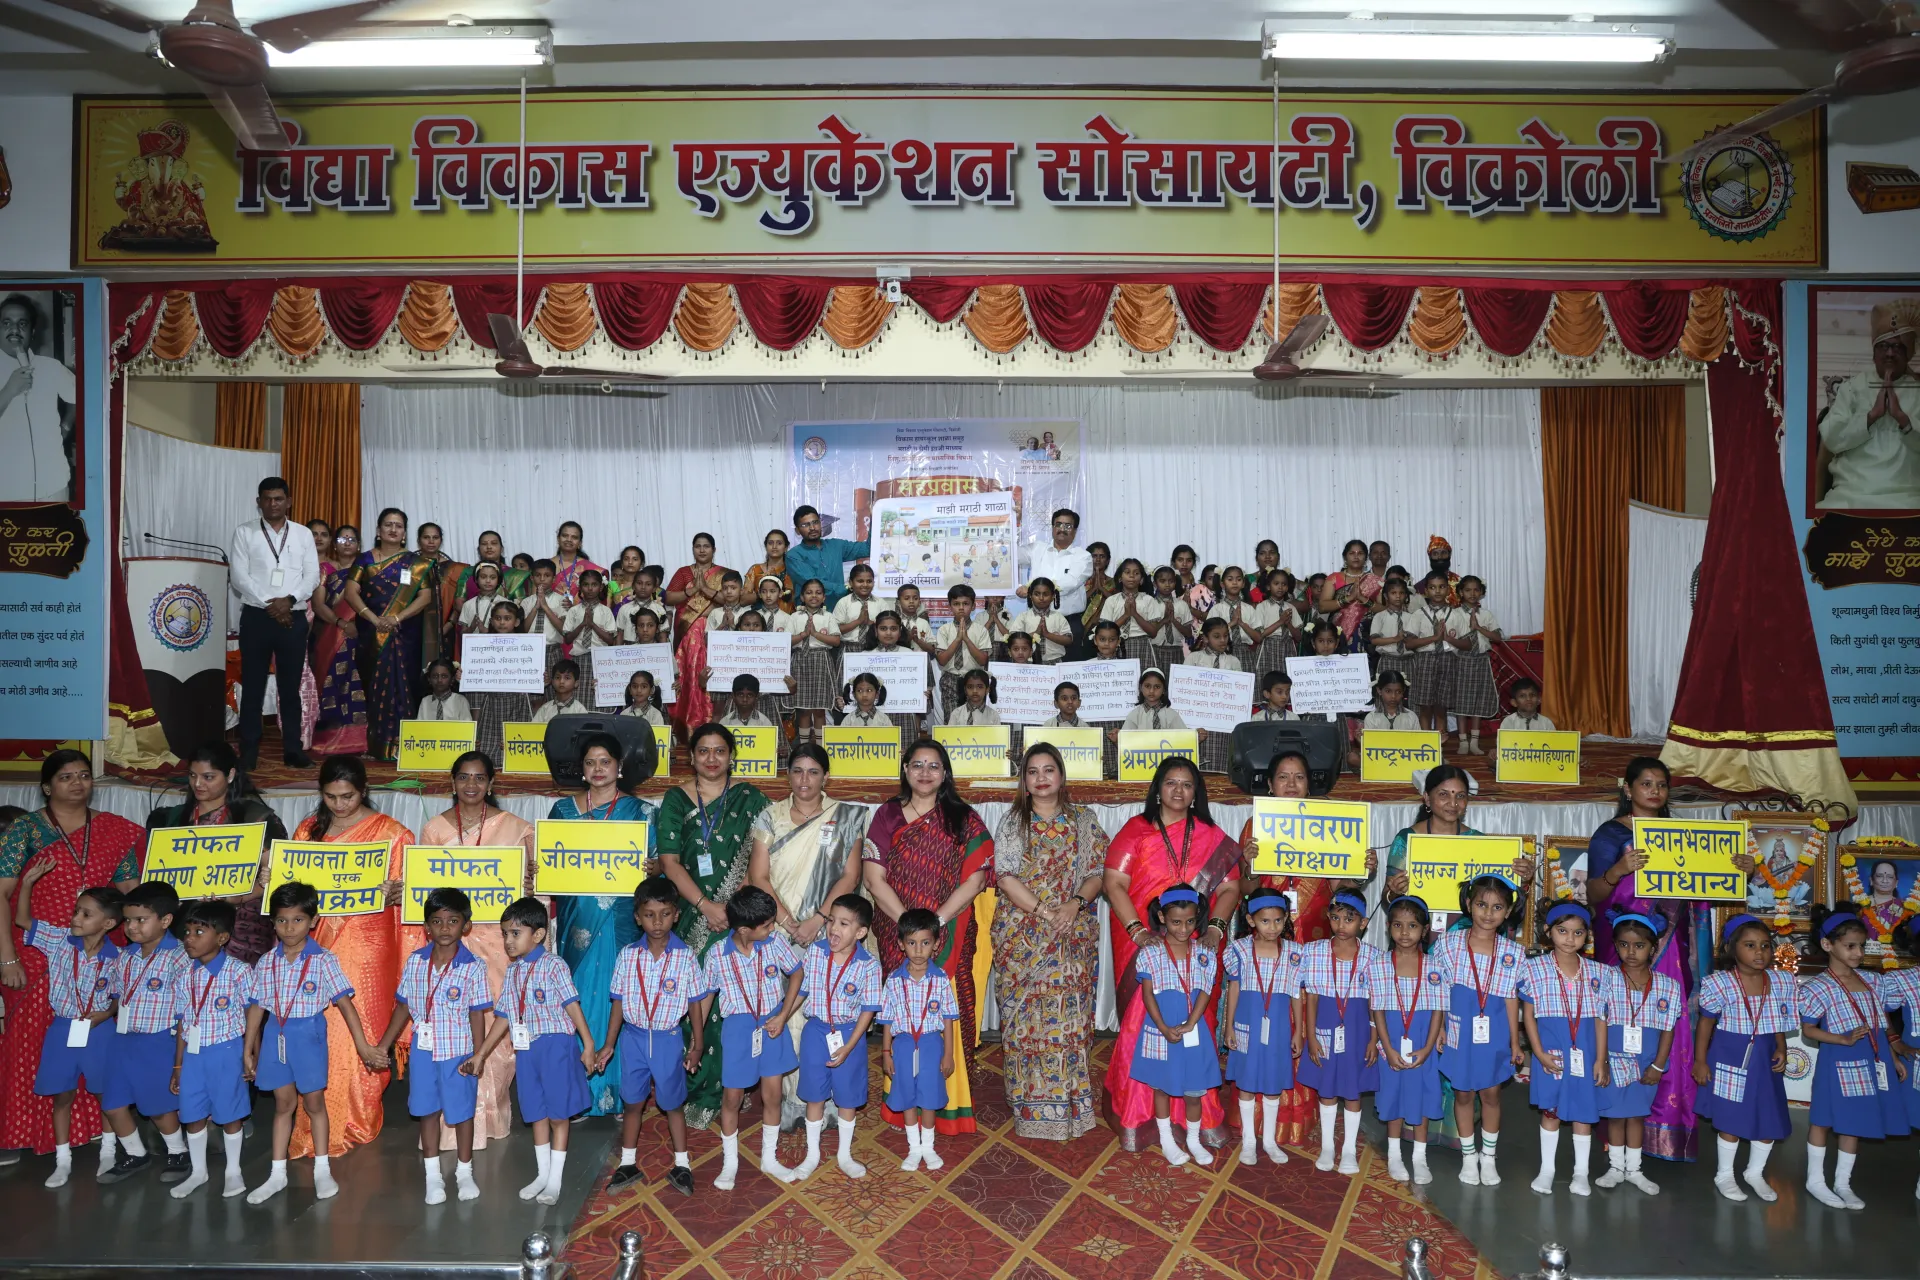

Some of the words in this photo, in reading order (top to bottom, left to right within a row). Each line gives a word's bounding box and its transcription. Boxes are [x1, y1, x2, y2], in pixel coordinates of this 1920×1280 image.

[410, 115, 652, 209] विकास
[673, 113, 1018, 235] एज्युकेशन
[1392, 113, 1663, 217] विक्रोळी
[936, 503, 956, 514] माझी
[960, 502, 981, 513] मराठी
[985, 503, 1007, 512] शाळा
[26, 527, 58, 538] कर
[8, 531, 75, 567] जुळती
[1824, 540, 1876, 569] माझे
[884, 574, 904, 585] माझी
[908, 573, 940, 585] अस्मिता
[30, 601, 43, 613] सर्व
[45, 602, 65, 614] काही
[67, 602, 82, 614] होतं
[1832, 605, 1878, 619] शून्यामधुनी
[1881, 605, 1900, 616] विश्व
[21, 632, 35, 640] एक
[37, 630, 54, 643] सुंदर
[56, 629, 68, 640] पर्व
[70, 630, 85, 642] होतं
[1830, 634, 1851, 646] किती
[1854, 634, 1879, 648] सुगंधी
[1881, 637, 1895, 648] वृक्ष
[34, 658, 59, 668] जाणीव
[62, 658, 78, 670] आहे
[713, 654, 733, 663] मराठी
[868, 656, 899, 665] अभिमान
[1063, 672, 1081, 680] मराठी
[1856, 666, 1877, 675] माया
[8, 685, 27, 696] मोठी
[29, 685, 49, 696] उणीव
[1832, 696, 1850, 705] सत्य
[1881, 692, 1900, 705] मार्ग
[1854, 725, 1876, 734] झाला
[1878, 723, 1898, 737] तुम्ही
[439, 740, 472, 752] समानता
[826, 736, 898, 760] वक्तशीरपणा
[1365, 743, 1438, 767] राष्ट्रभक्ती
[1501, 742, 1576, 771] सर्वधर्मसहिष्णुता
[1258, 802, 1364, 844] पर्यावरण
[171, 829, 245, 855] मोफत
[1642, 827, 1741, 868] स्वानुभवाला
[282, 849, 348, 880] गुणवत्ता
[428, 850, 502, 878] मोफत
[540, 841, 643, 881] जीवनमूल्ये
[1274, 842, 1351, 871] शिक्षण
[203, 862, 257, 888] आहार
[332, 872, 362, 888] पुरक
[1411, 861, 1458, 888] सुसज्ज
[1643, 870, 1740, 895] प्राधान्य
